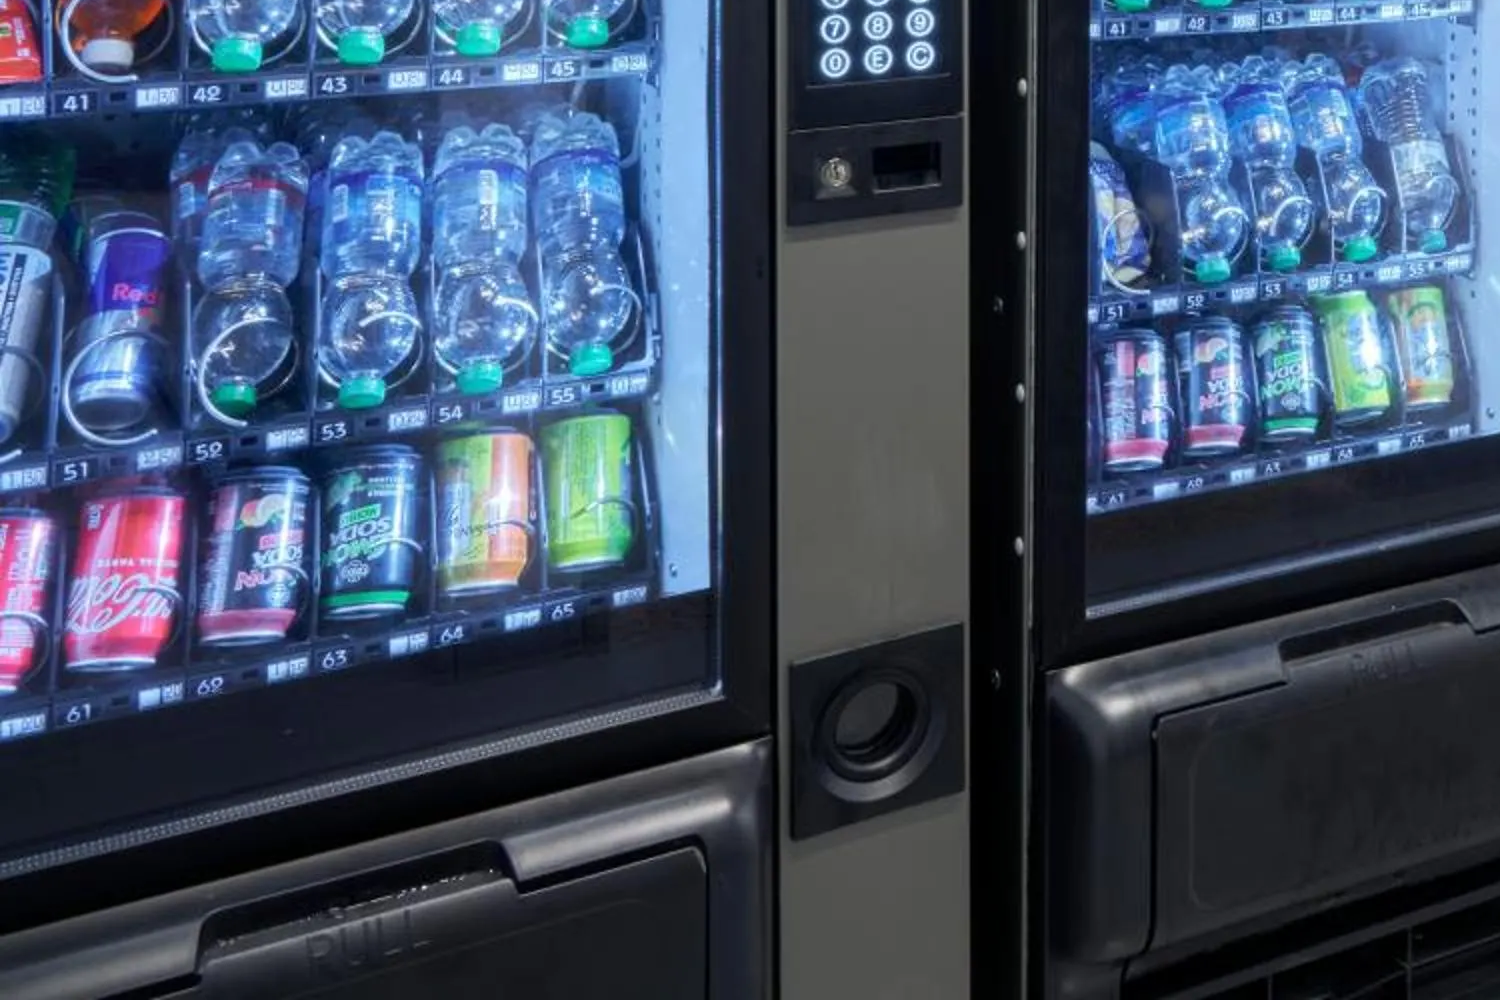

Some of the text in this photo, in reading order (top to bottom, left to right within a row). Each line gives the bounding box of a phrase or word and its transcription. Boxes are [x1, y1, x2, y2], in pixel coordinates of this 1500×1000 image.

[439, 69, 463, 84] 44
[551, 62, 574, 77] 45
[193, 86, 221, 101] 42
[321, 78, 346, 93] 43
[63, 94, 89, 110] 41
[551, 390, 574, 405] 55
[439, 407, 463, 422] 54
[321, 424, 346, 440] 53
[196, 442, 222, 460] 52
[63, 463, 88, 481] 51
[552, 604, 574, 620] 65
[441, 626, 463, 642] 64
[323, 651, 346, 668] 63
[197, 678, 223, 695] 62
[67, 704, 90, 722] 61
[305, 909, 434, 976] PULL
